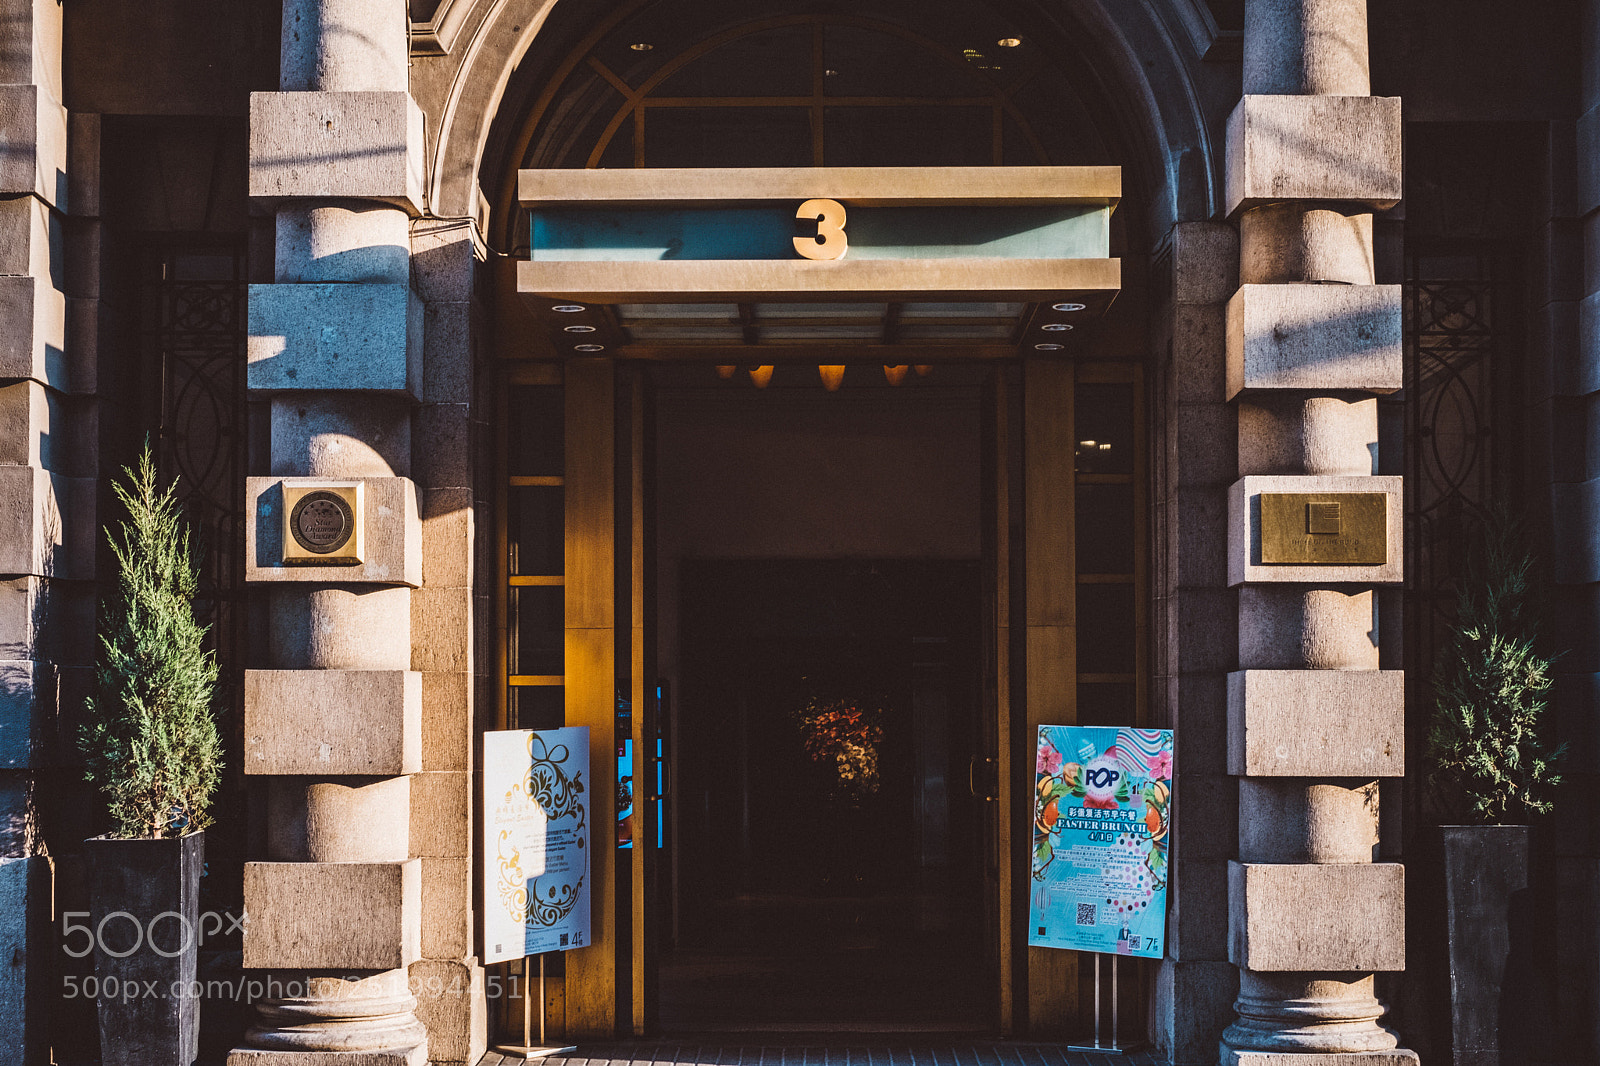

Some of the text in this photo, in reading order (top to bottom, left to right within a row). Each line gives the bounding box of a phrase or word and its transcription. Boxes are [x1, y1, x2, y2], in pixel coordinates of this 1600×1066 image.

[793, 198, 848, 261] 3
[1085, 767, 1120, 788] POP
[1057, 819, 1147, 833] EASTER BRUNCH
